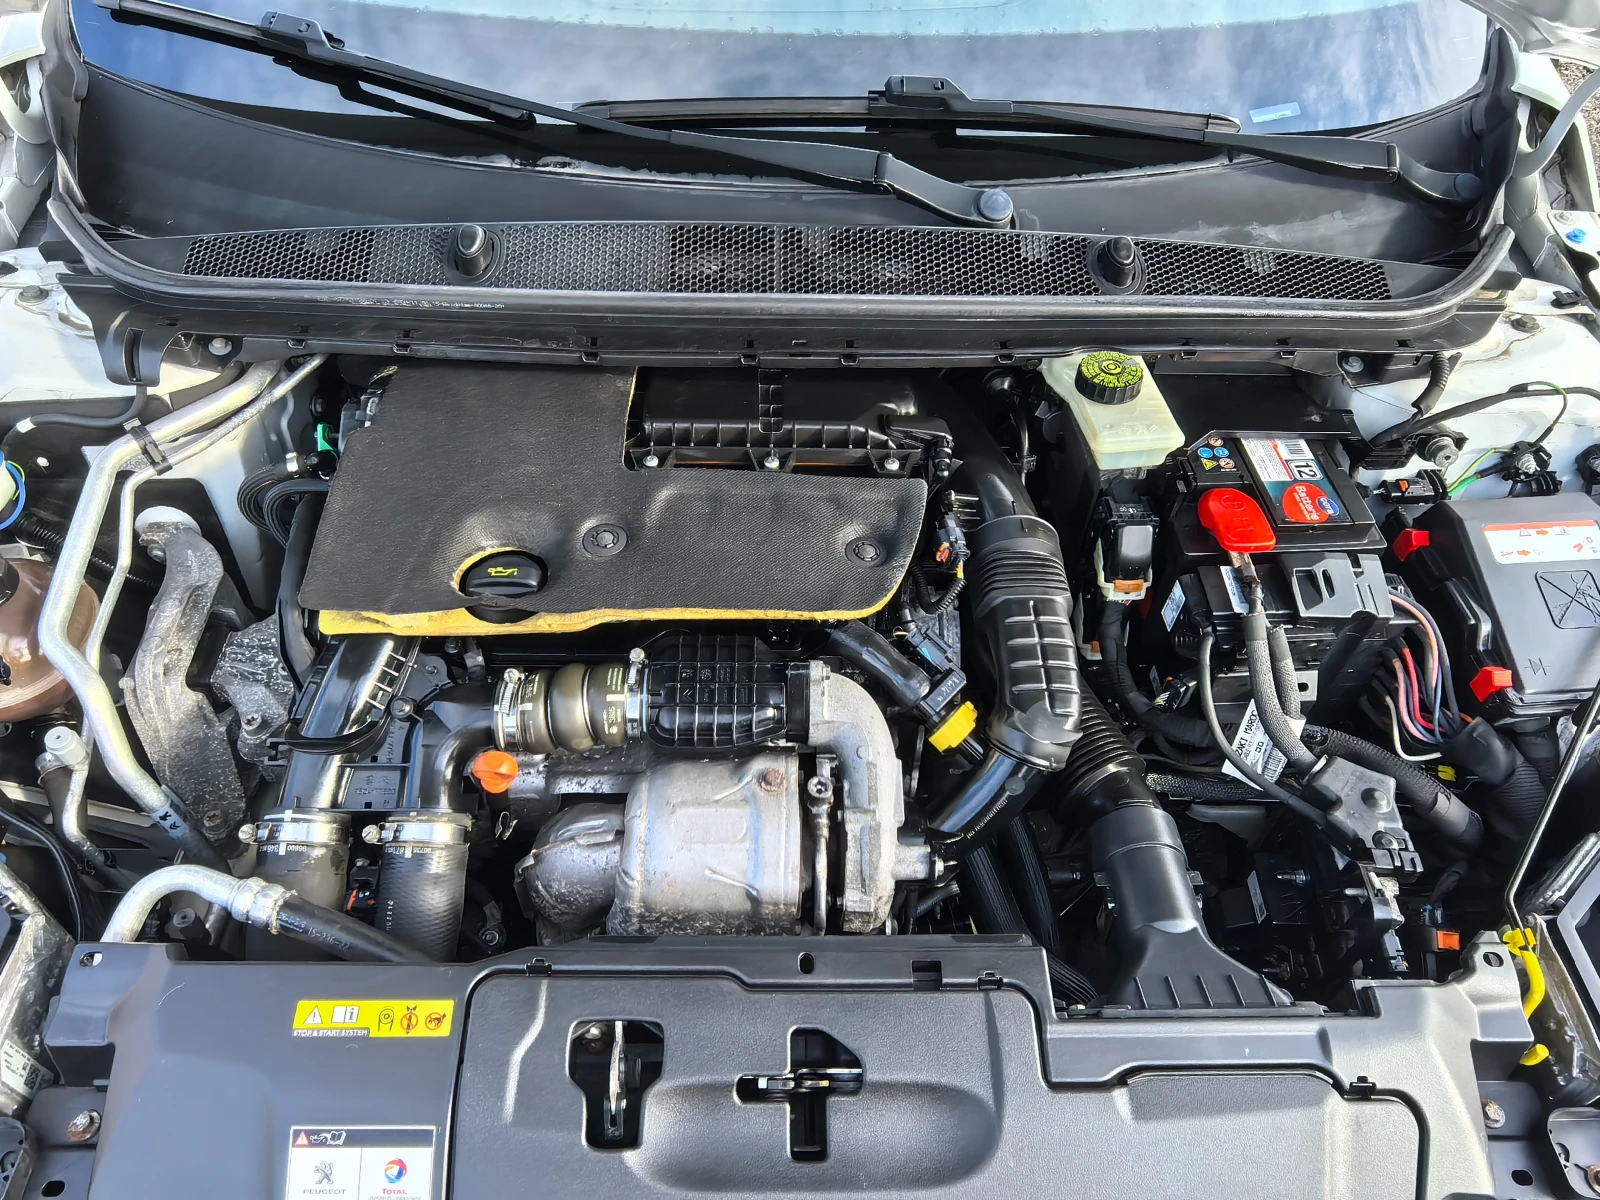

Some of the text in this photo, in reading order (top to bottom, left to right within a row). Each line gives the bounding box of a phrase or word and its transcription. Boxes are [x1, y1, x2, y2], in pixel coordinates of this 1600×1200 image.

[1295, 462, 1318, 478] 12
[1295, 485, 1320, 521] Batterie
[1235, 737, 1248, 757] ZAKI
[293, 1028, 368, 1037] STOP & START SYSTEM
